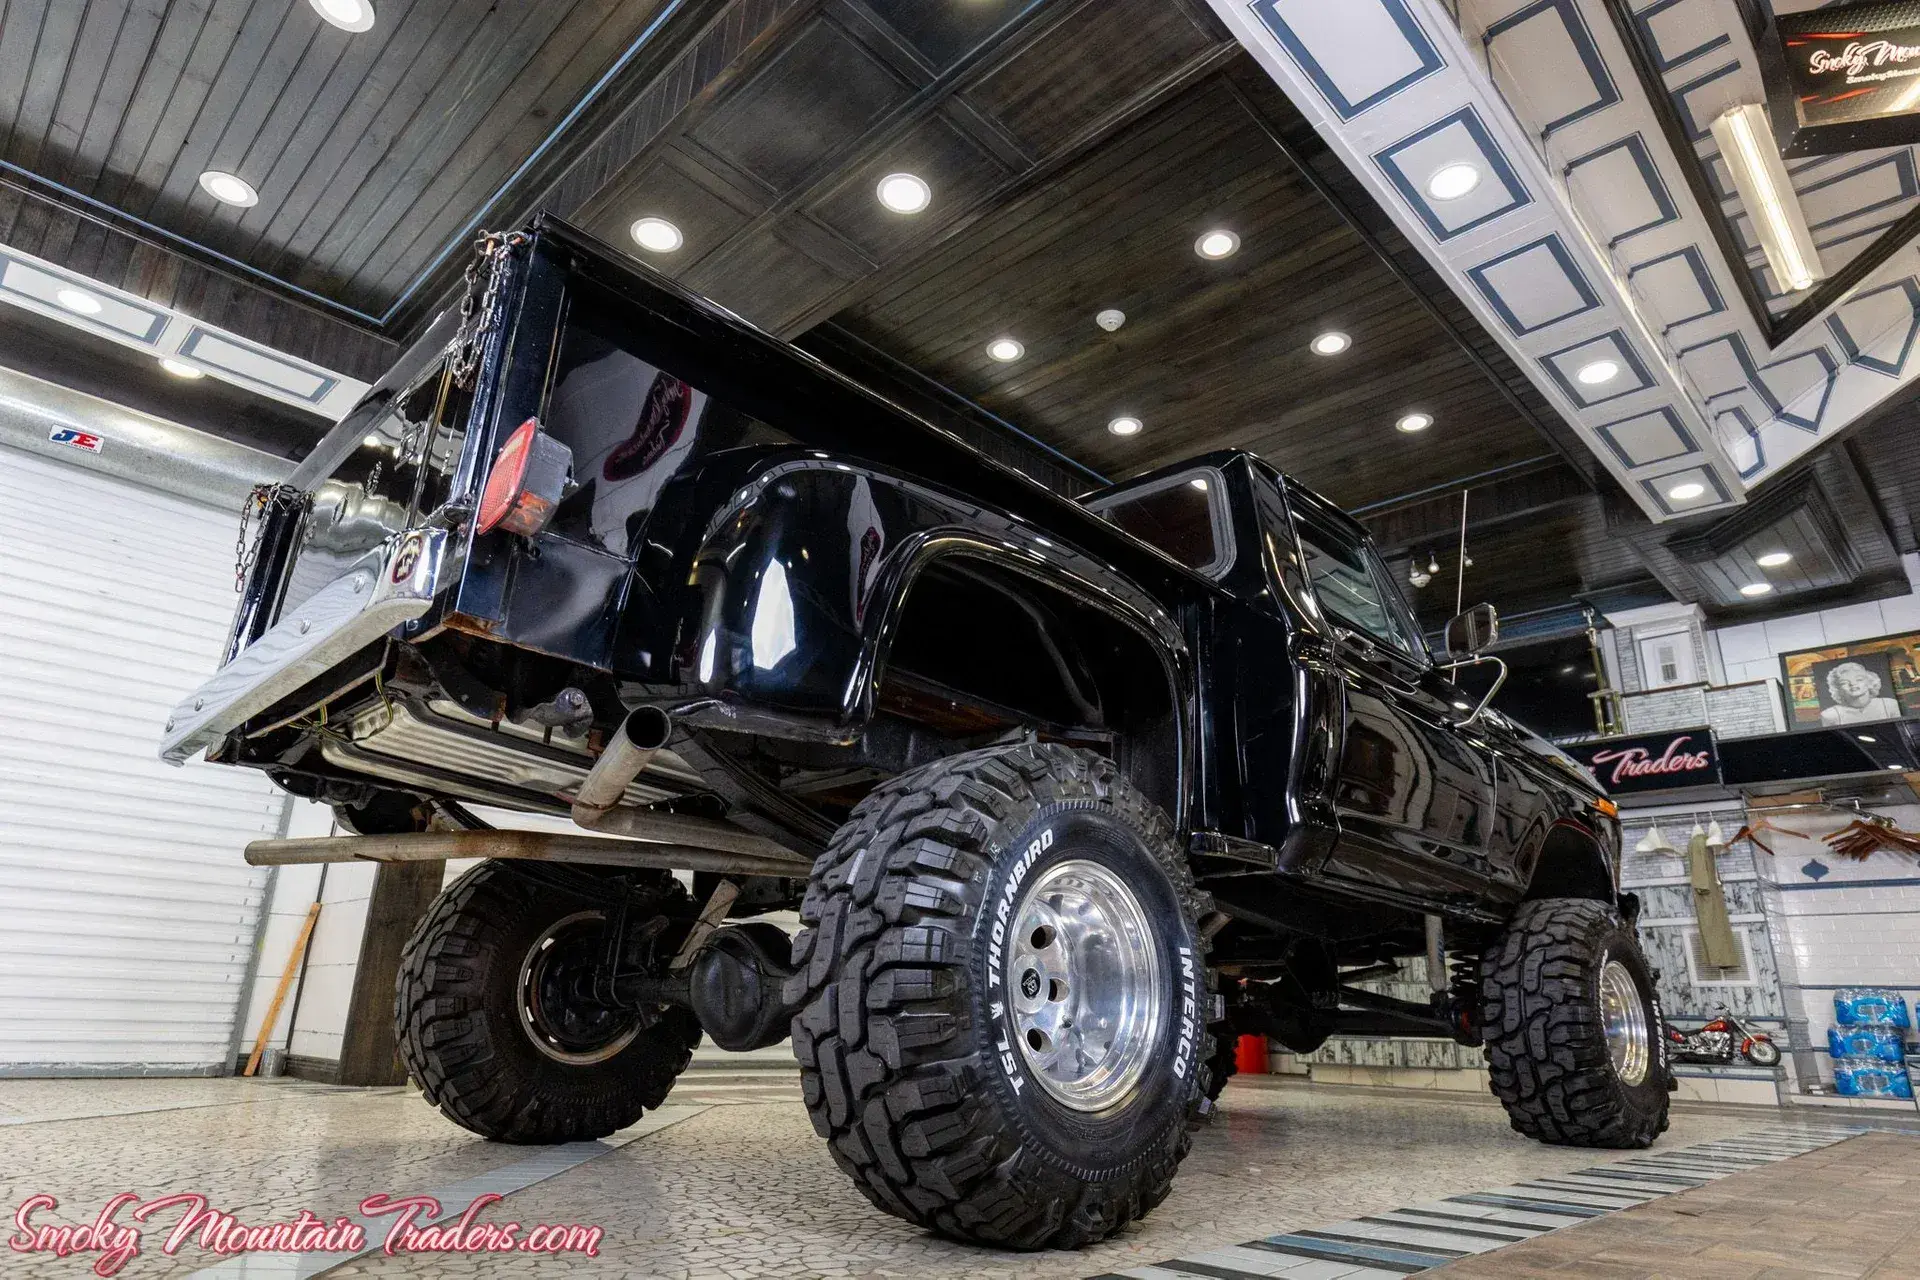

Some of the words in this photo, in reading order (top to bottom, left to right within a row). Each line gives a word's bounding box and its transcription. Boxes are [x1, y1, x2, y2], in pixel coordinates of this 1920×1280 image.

[1809, 41, 1869, 76] Smoky
[51, 429, 99, 449] JE
[1592, 736, 1709, 784] Traders
[989, 828, 1053, 988] THORNBIRD
[1173, 946, 1195, 1079] INTERCO
[997, 1027, 1025, 1096] TSL
